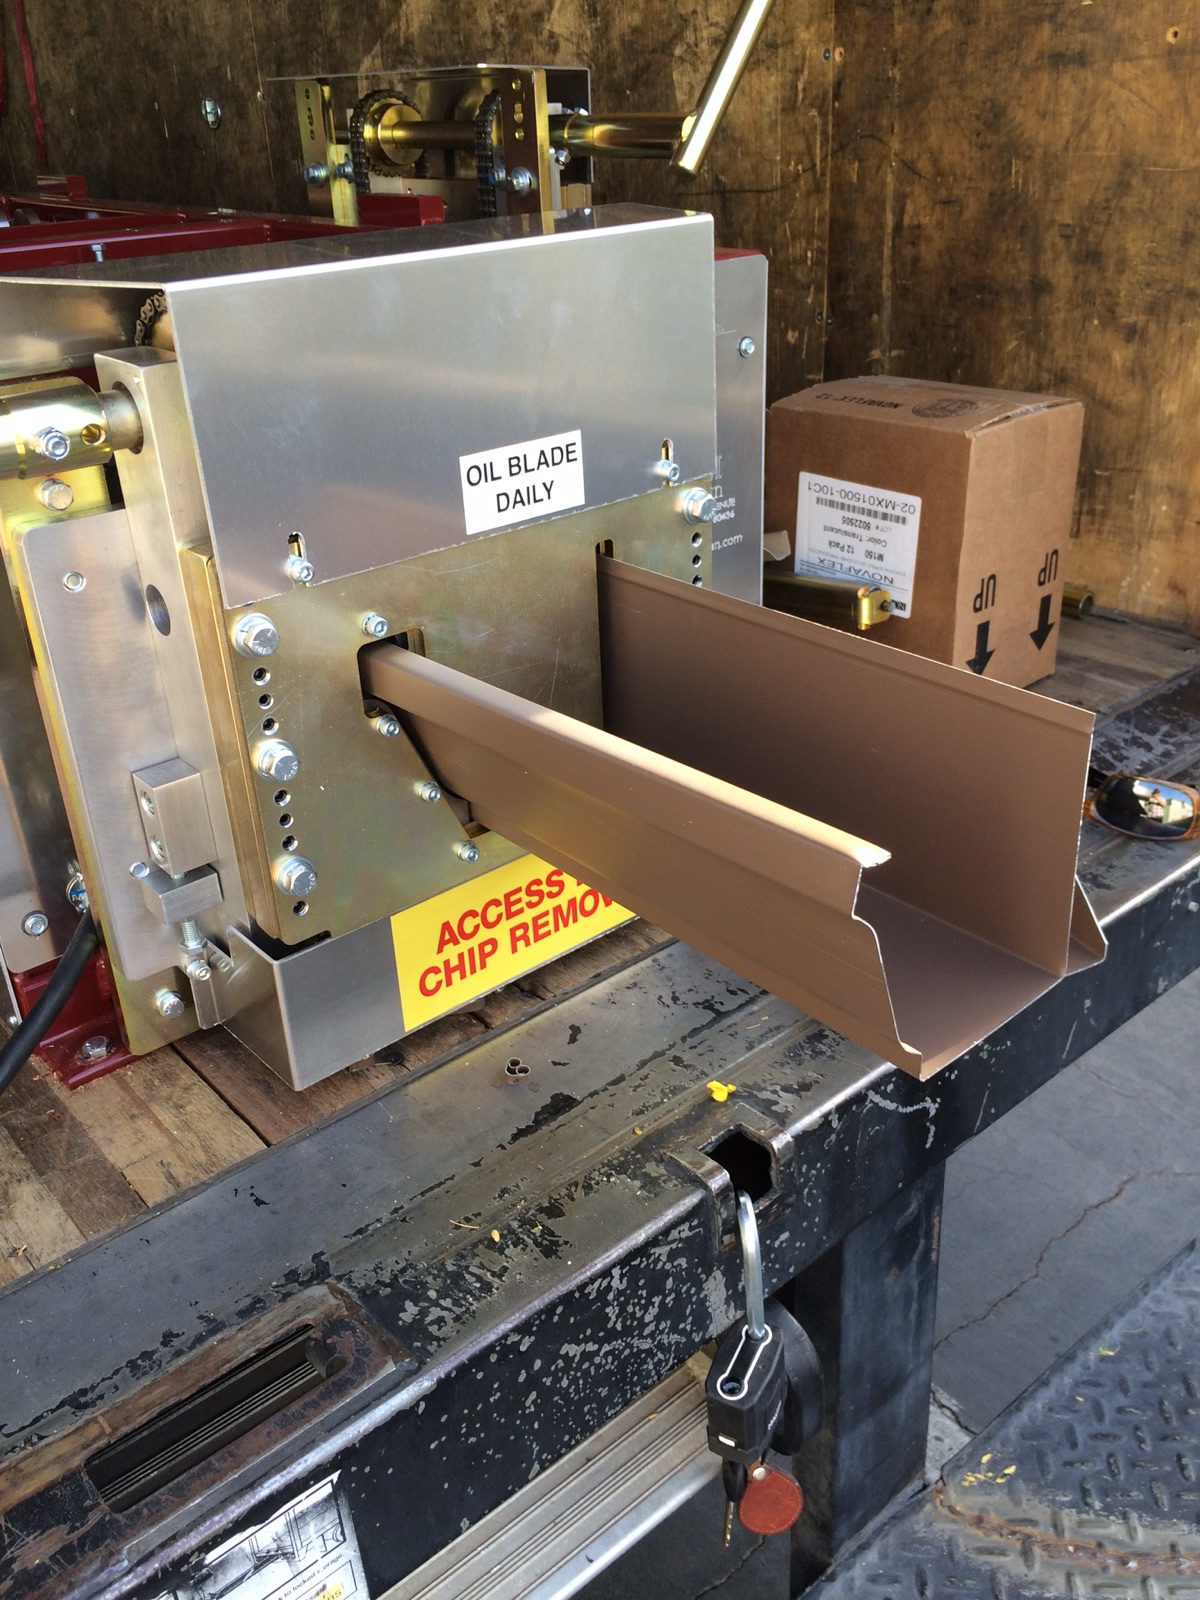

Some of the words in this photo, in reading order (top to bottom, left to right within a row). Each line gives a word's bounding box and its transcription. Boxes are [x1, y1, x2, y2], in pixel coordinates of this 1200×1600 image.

[466, 461, 502, 487] OIL
[508, 442, 578, 477] BLADE
[496, 480, 554, 513] DAILY
[807, 481, 916, 515] 02-MX01500-10C1
[823, 524, 863, 542] Translucent
[841, 515, 871, 531] 5022505
[828, 540, 845, 553] Pack
[847, 544, 854, 554] 12
[864, 549, 884, 562] M150
[865, 536, 888, 548] Color:
[817, 556, 894, 585] NOVAFLEX
[1038, 548, 1059, 587] UP
[973, 573, 996, 614] UP
[436, 868, 565, 955] ACCESS
[418, 937, 498, 997] CHIP
[292, 1572, 316, 1591] locked
